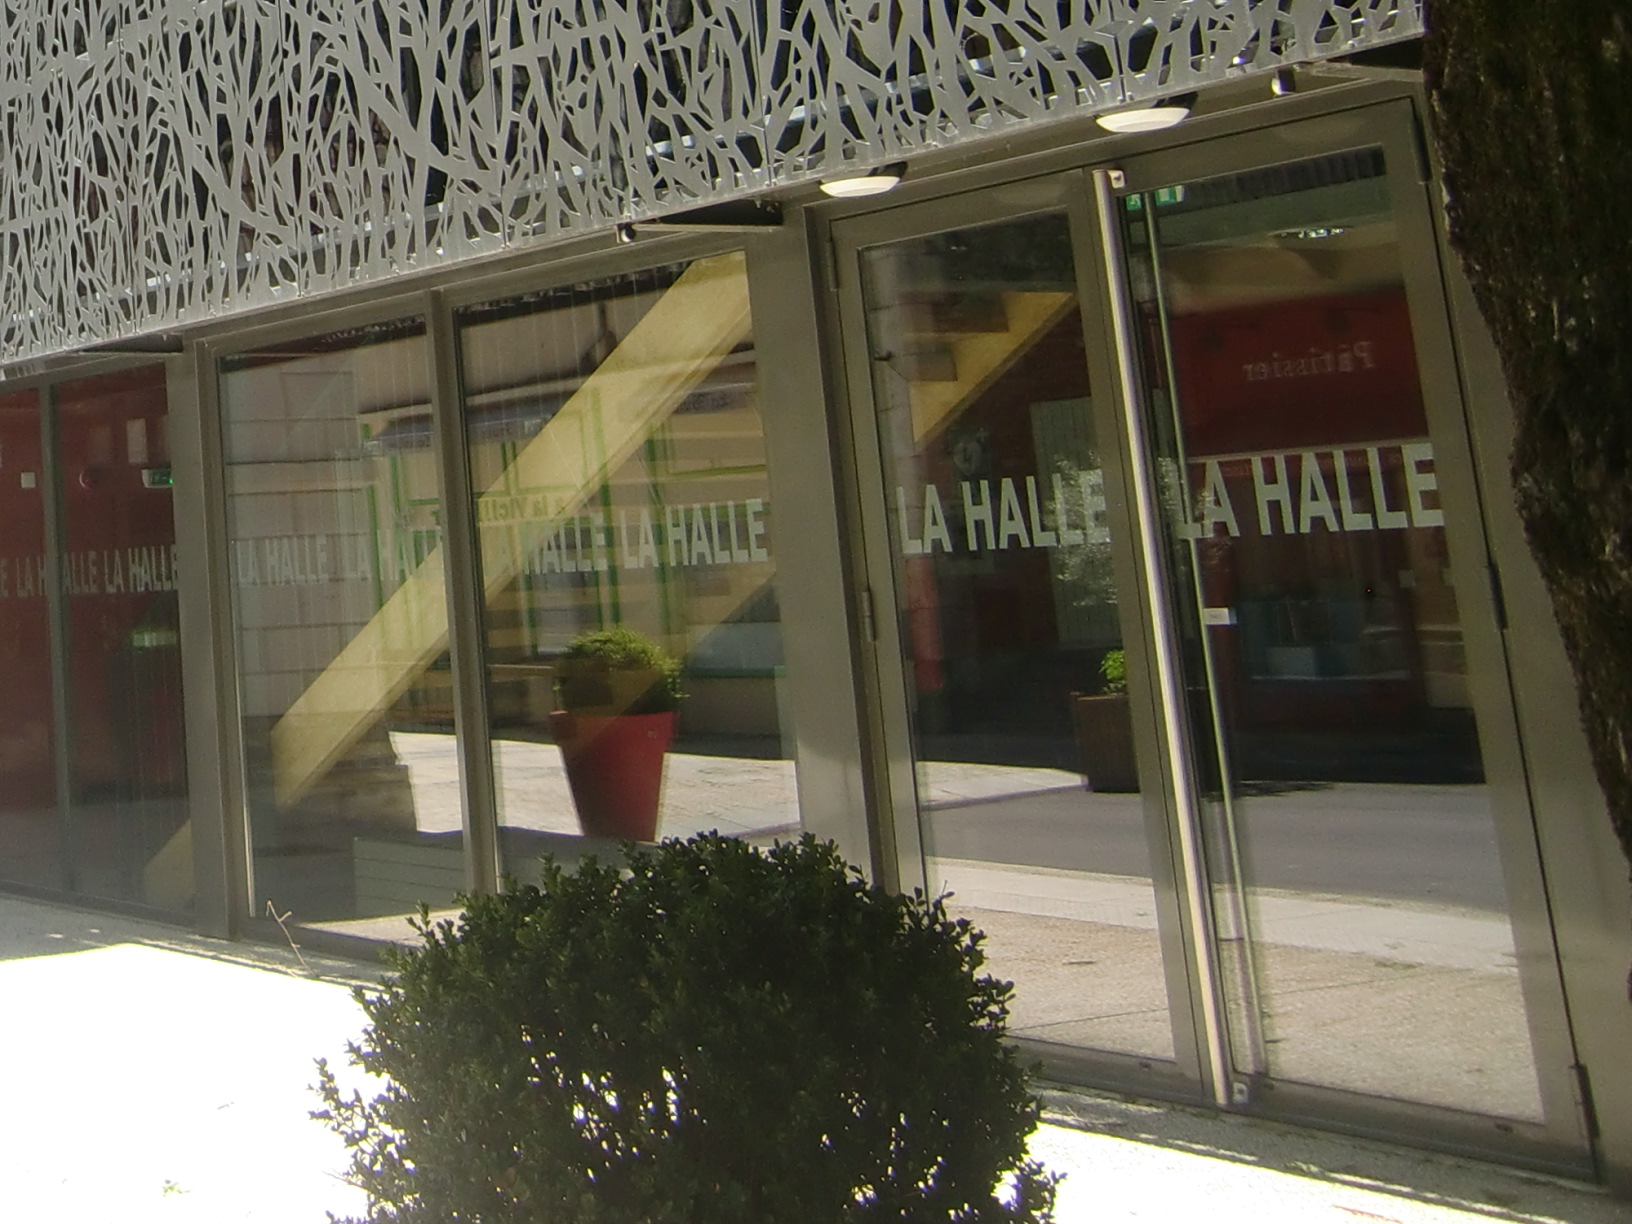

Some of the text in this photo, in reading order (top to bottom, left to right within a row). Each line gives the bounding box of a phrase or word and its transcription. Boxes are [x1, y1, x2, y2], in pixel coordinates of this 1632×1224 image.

[896, 469, 1111, 554] LA HALLE
[1166, 442, 1445, 538] LA HALLE
[265, 535, 329, 586] HALLE
[620, 507, 659, 569] LA
[665, 498, 768, 567] HALLE
[16, 556, 34, 597] LA
[103, 548, 125, 594] LA
